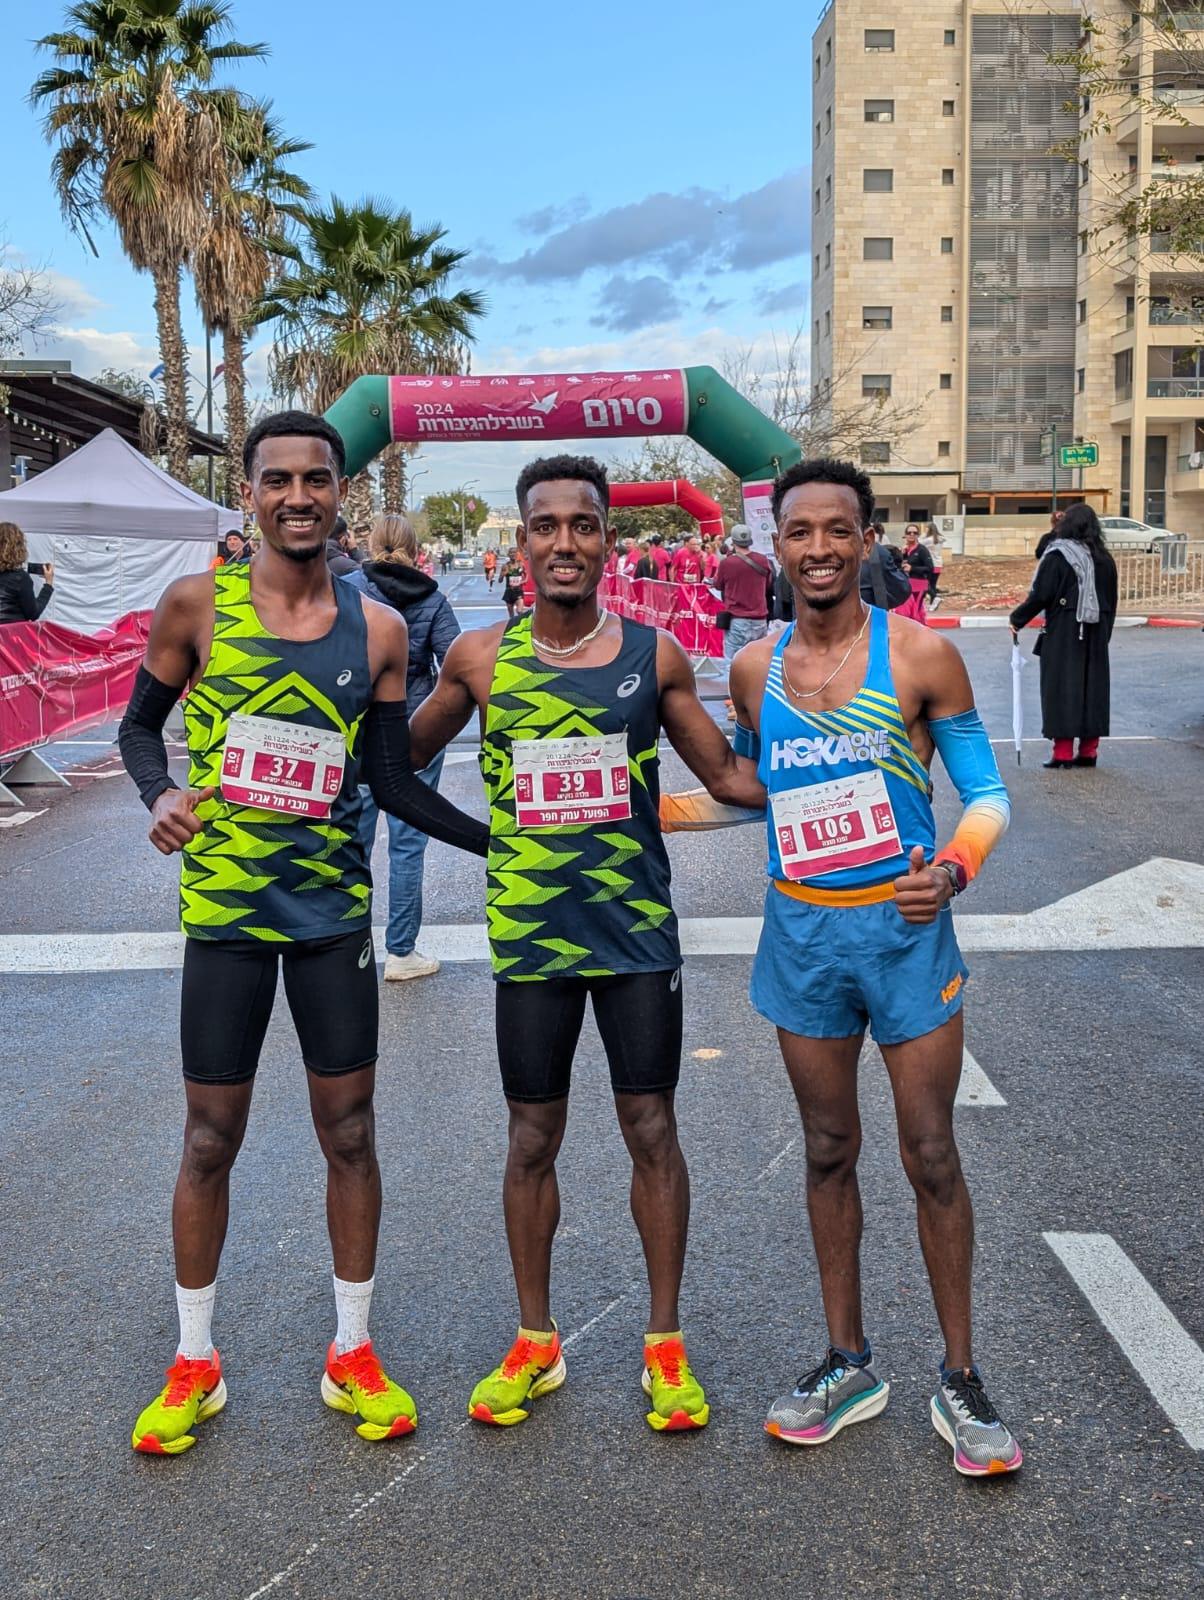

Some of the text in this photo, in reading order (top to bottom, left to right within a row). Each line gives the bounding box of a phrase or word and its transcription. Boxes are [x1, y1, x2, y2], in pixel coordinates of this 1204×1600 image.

[413, 403, 455, 416] 2024
[582, 396, 662, 427] סיום
[770, 730, 889, 771] HOKA ONE
[855, 744, 892, 761] ONE
[226, 751, 236, 766] 10
[270, 757, 299, 779] 37
[329, 778, 338, 791] 10
[518, 778, 527, 790] 10
[560, 772, 585, 793] 39
[618, 778, 627, 791] 10
[247, 791, 309, 811] מכבי תל אביב
[539, 808, 610, 823] הפועל עמק חפר
[880, 814, 892, 828] 10
[810, 814, 852, 841] 106
[780, 831, 790, 844] 10
